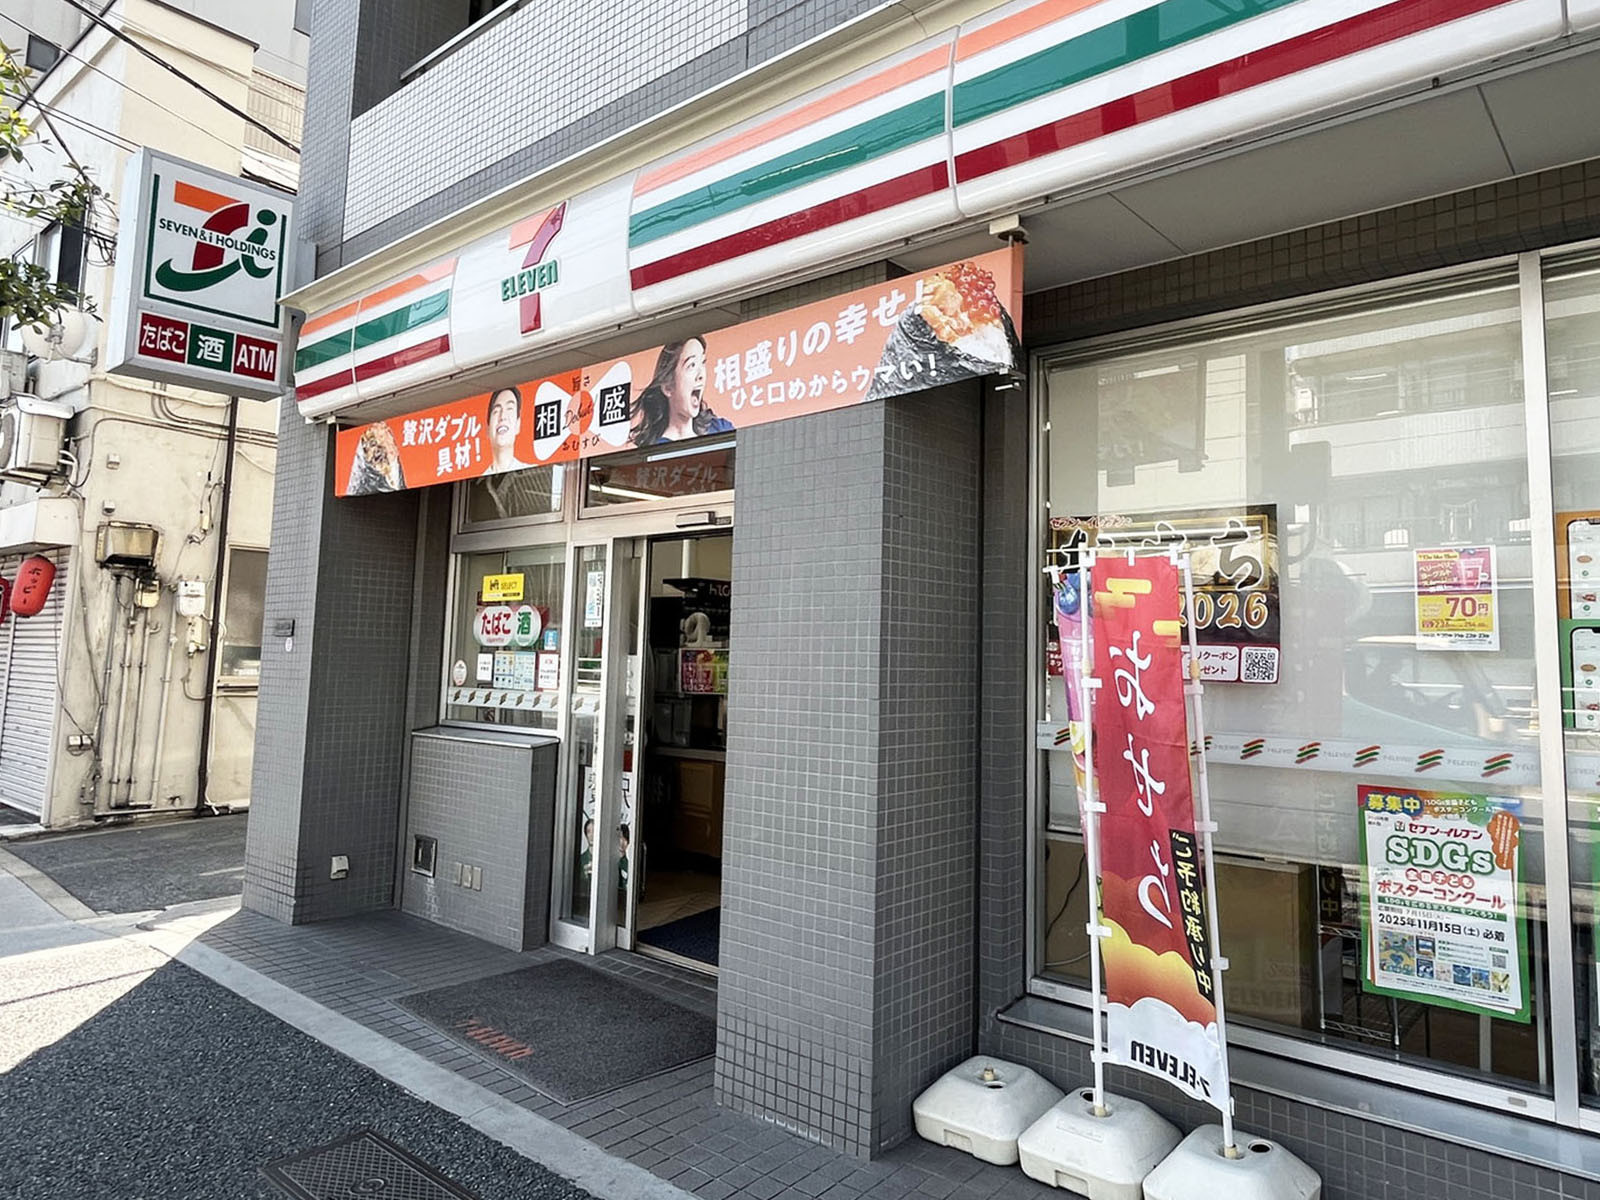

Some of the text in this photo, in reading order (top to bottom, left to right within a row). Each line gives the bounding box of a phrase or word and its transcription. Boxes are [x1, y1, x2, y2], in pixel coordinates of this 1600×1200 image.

[216, 236, 276, 261] HOLDINGS
[141, 322, 185, 355] たばこ
[197, 334, 226, 363] 酒
[236, 343, 275, 373] ATM
[731, 353, 938, 411] ひと口めからウマい!
[402, 413, 482, 447] 贅沢ダブル
[562, 433, 602, 451] おむすび
[436, 440, 482, 476] 具材!
[481, 611, 512, 636] たばこ
[517, 611, 532, 636] 酒
[1367, 793, 1421, 813] 募集中
[1386, 835, 1495, 876] SDGs
[1377, 879, 1507, 909] ポスターコンクール
